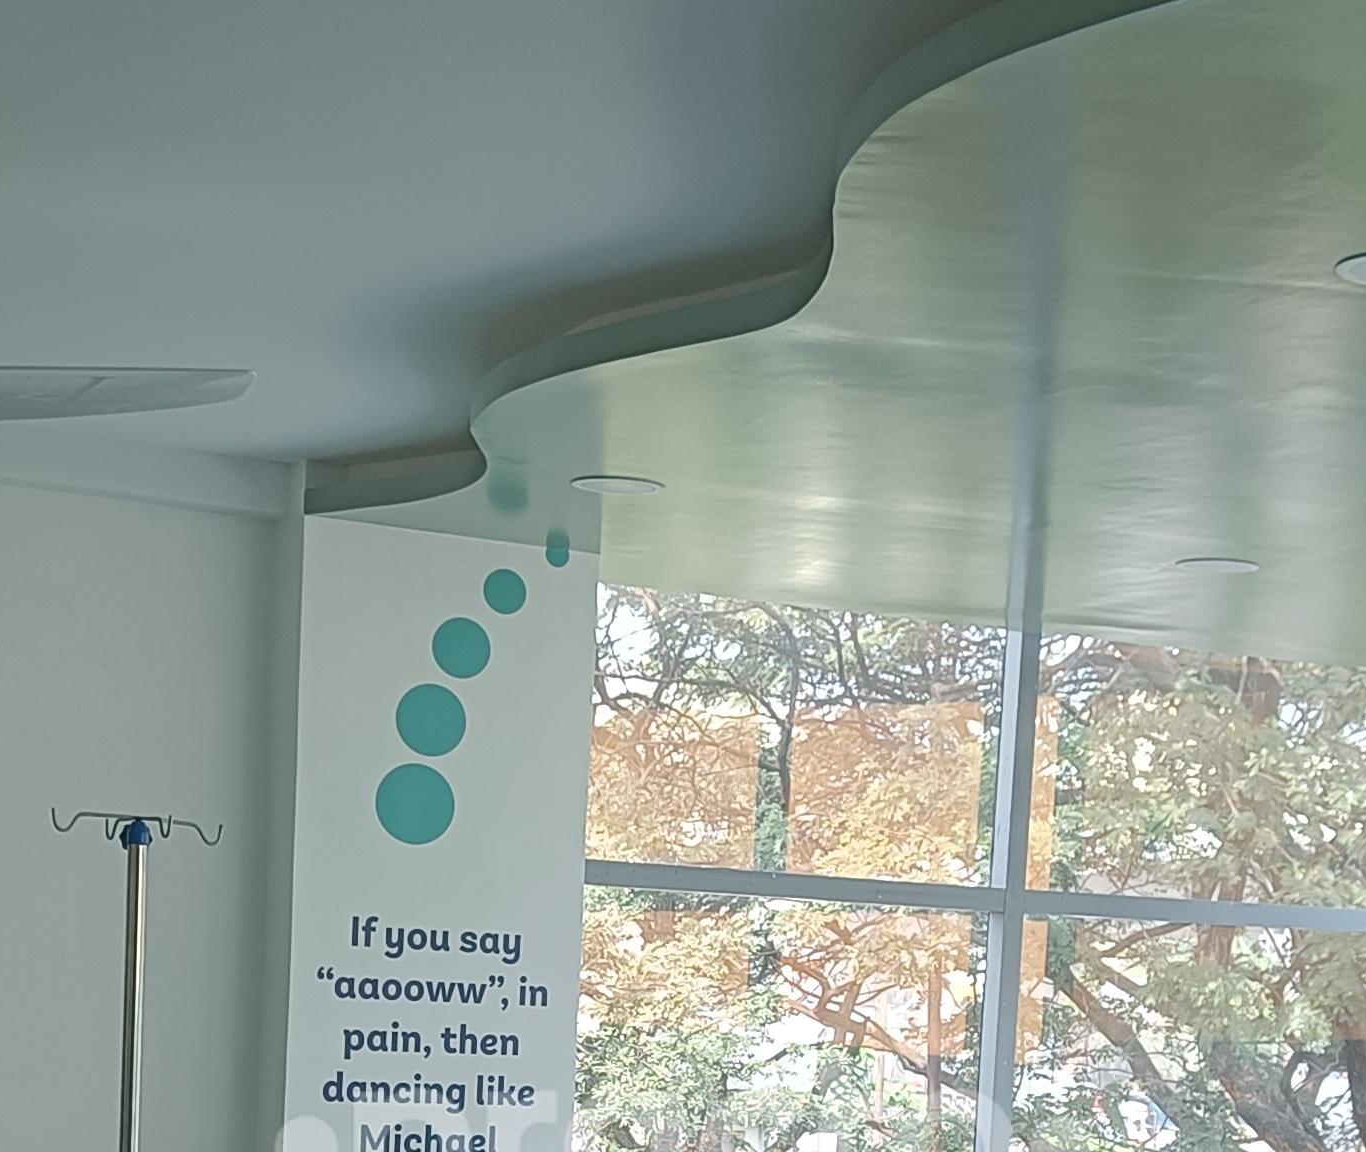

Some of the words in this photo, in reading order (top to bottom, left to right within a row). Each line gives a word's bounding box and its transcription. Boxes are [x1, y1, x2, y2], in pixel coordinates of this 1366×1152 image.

[351, 916, 379, 947] If
[384, 926, 450, 959] you
[459, 931, 521, 965] say
[519, 976, 547, 1007] in
[343, 1021, 432, 1060] pain,
[441, 1024, 519, 1056] then
[322, 1071, 466, 1114] dancing
[476, 1075, 535, 1106] like
